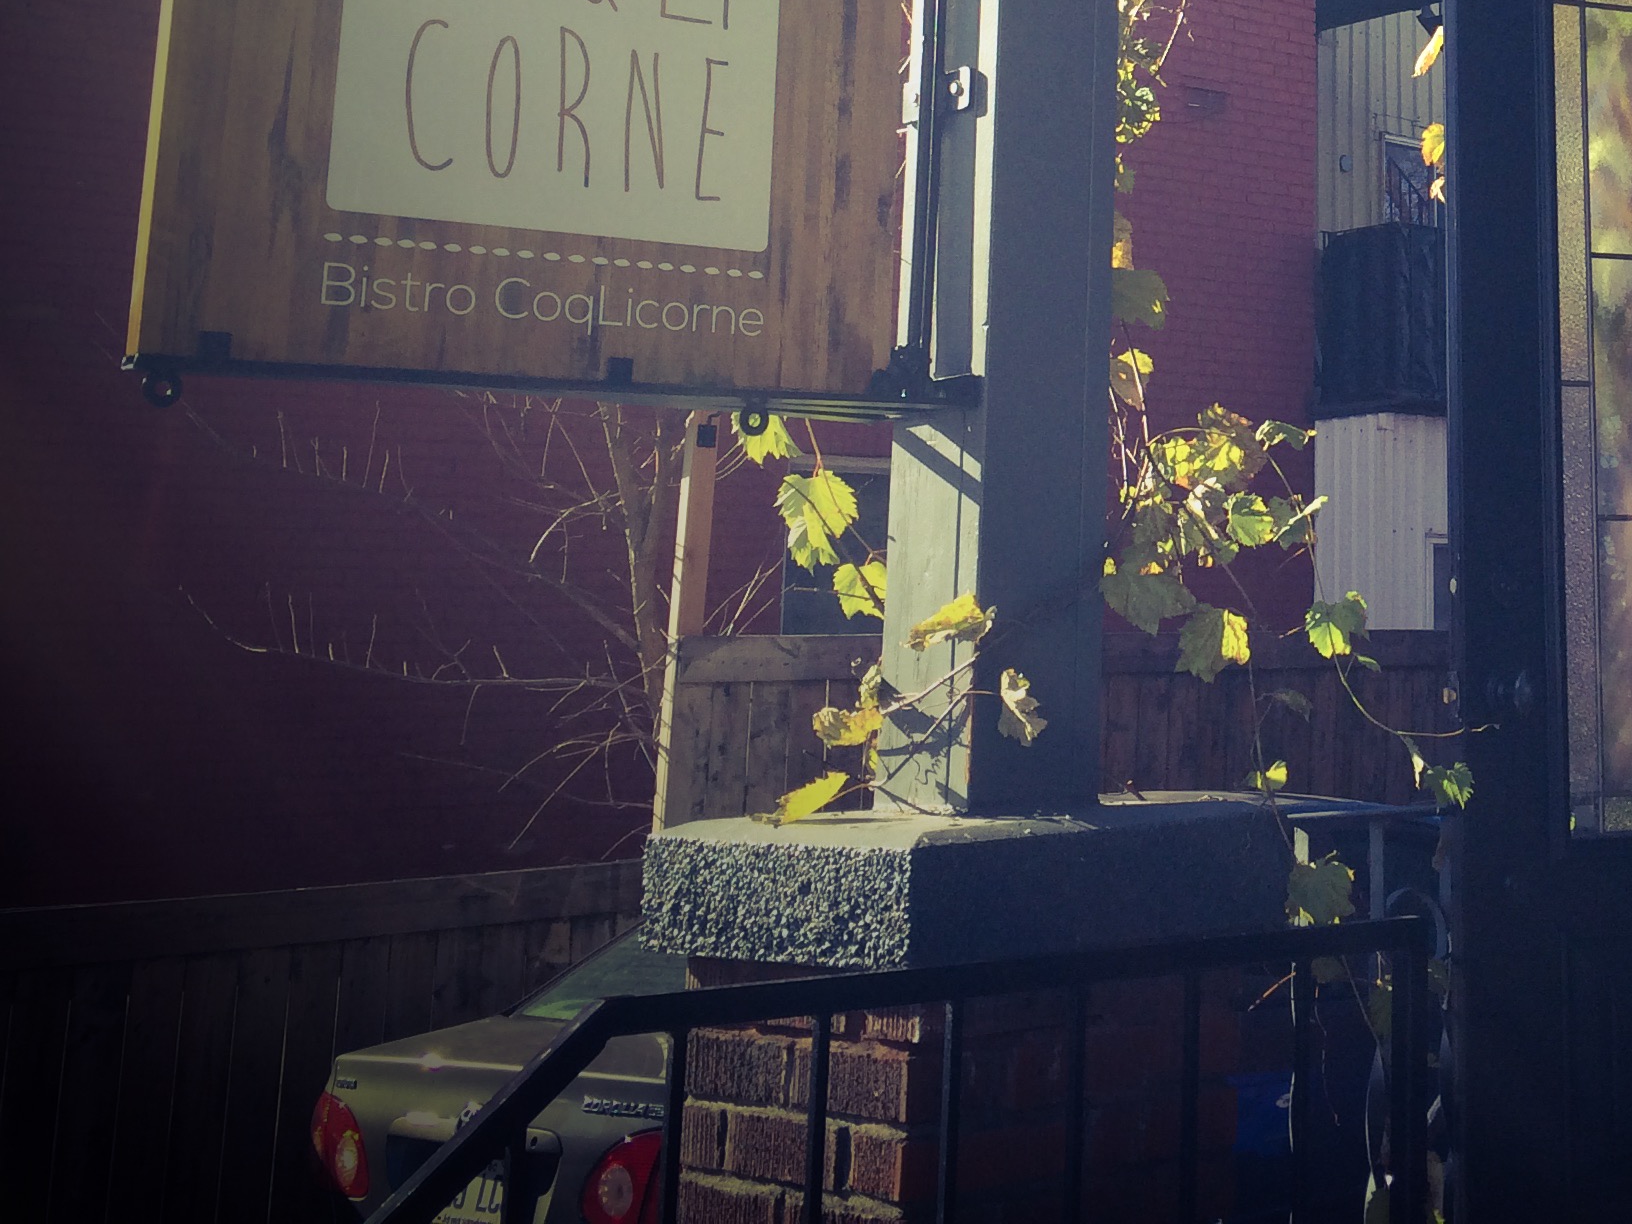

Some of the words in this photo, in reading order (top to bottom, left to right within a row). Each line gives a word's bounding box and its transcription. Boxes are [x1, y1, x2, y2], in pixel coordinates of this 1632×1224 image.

[405, 19, 730, 202] CORNE
[320, 262, 477, 316] Bistro
[494, 277, 765, 336] CoqLicorne
